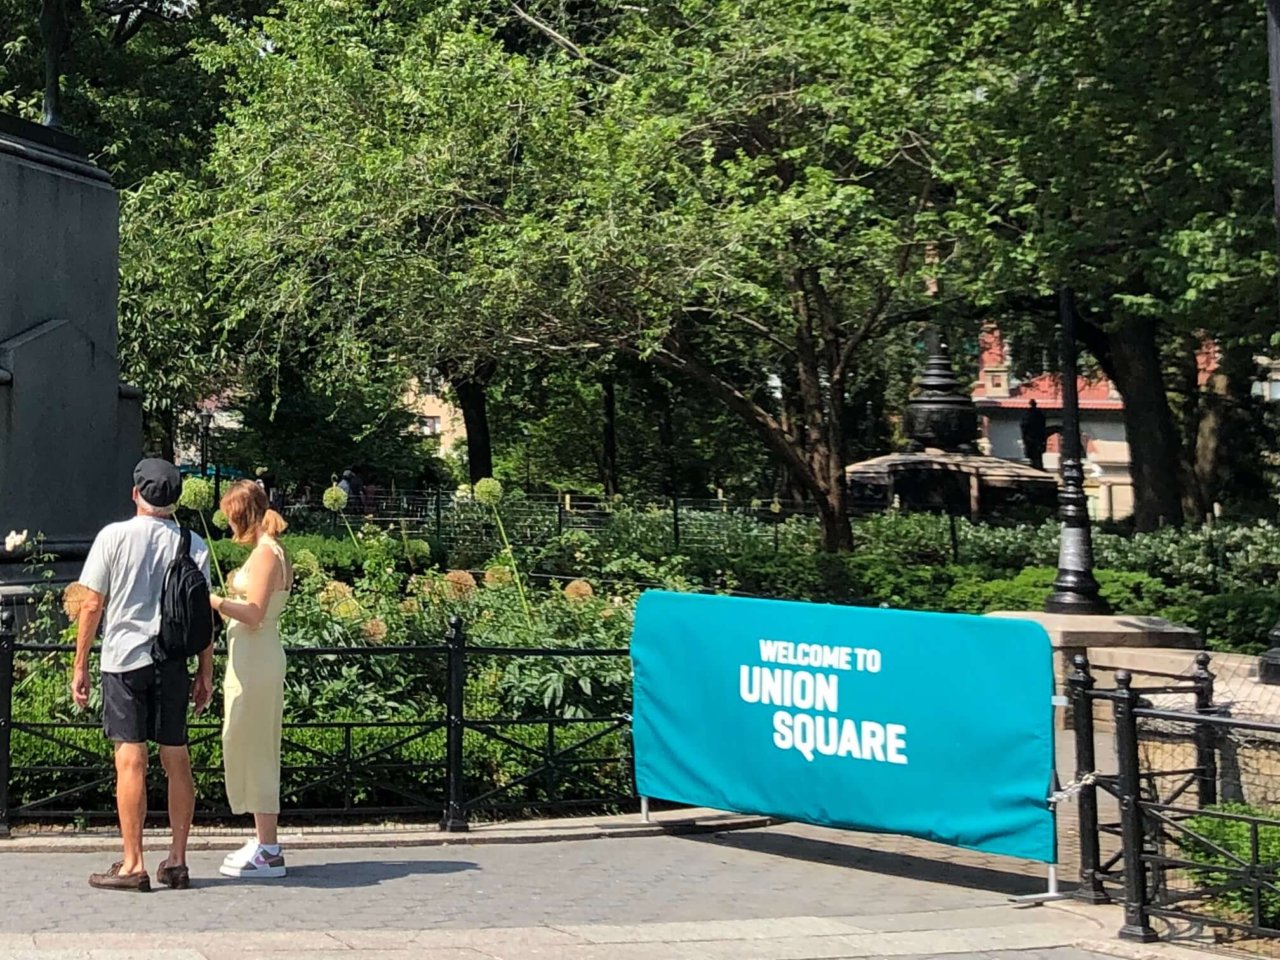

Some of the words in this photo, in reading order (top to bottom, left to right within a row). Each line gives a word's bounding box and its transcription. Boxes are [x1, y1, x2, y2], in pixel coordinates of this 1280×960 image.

[759, 639, 852, 670] WELCOME
[854, 648, 881, 673] TO
[740, 665, 838, 712] UNION
[773, 710, 908, 764] SQUARE
